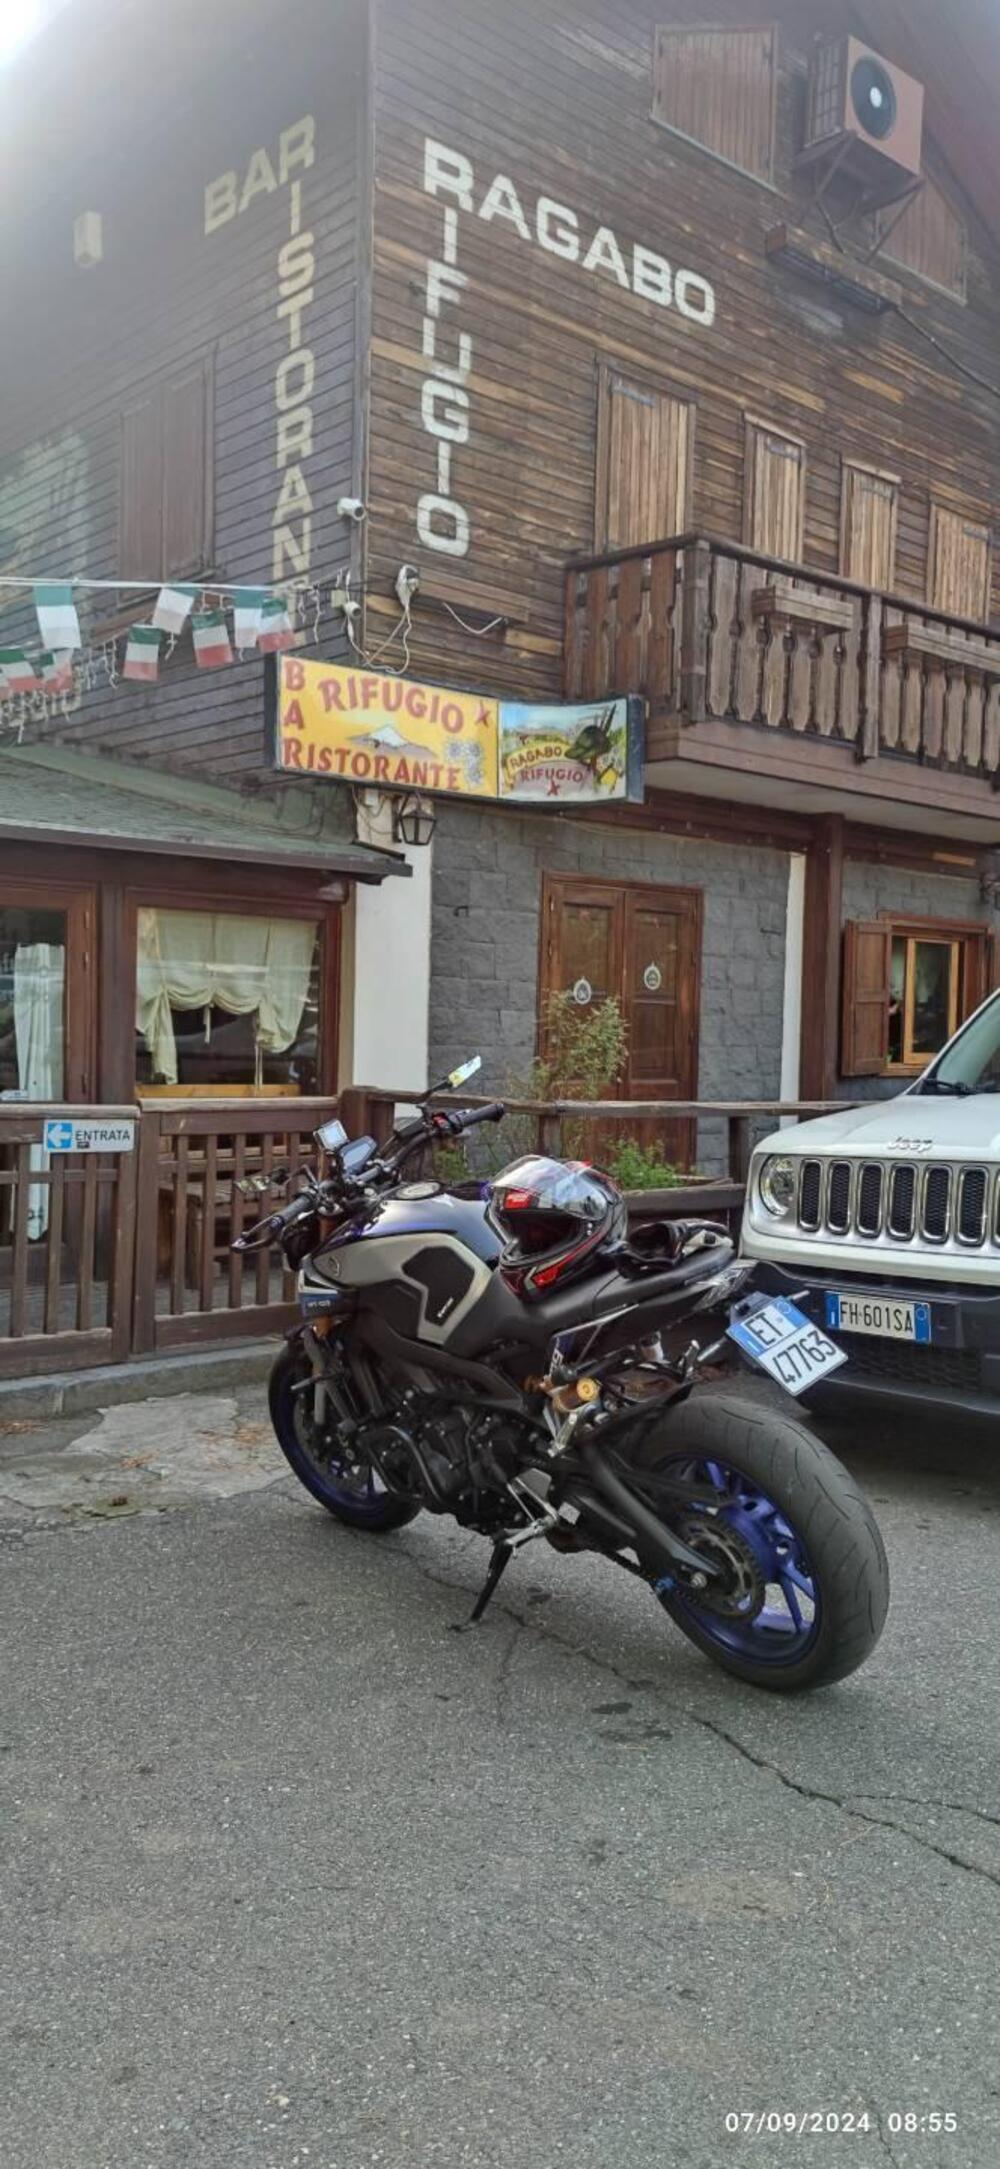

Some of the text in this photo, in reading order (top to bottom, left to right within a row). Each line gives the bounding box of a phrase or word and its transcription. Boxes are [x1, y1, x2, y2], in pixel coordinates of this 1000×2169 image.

[204, 114, 314, 236] BAR
[424, 137, 715, 326] RAGABO
[317, 675, 464, 734] RIFUGIO
[284, 737, 460, 791] RISTORANTE
[510, 746, 562, 769] RAGABO
[520, 766, 583, 783] RIFUGIO
[75, 1129, 130, 1141] ENTRATA
[772, 1330, 837, 1385] 47763
